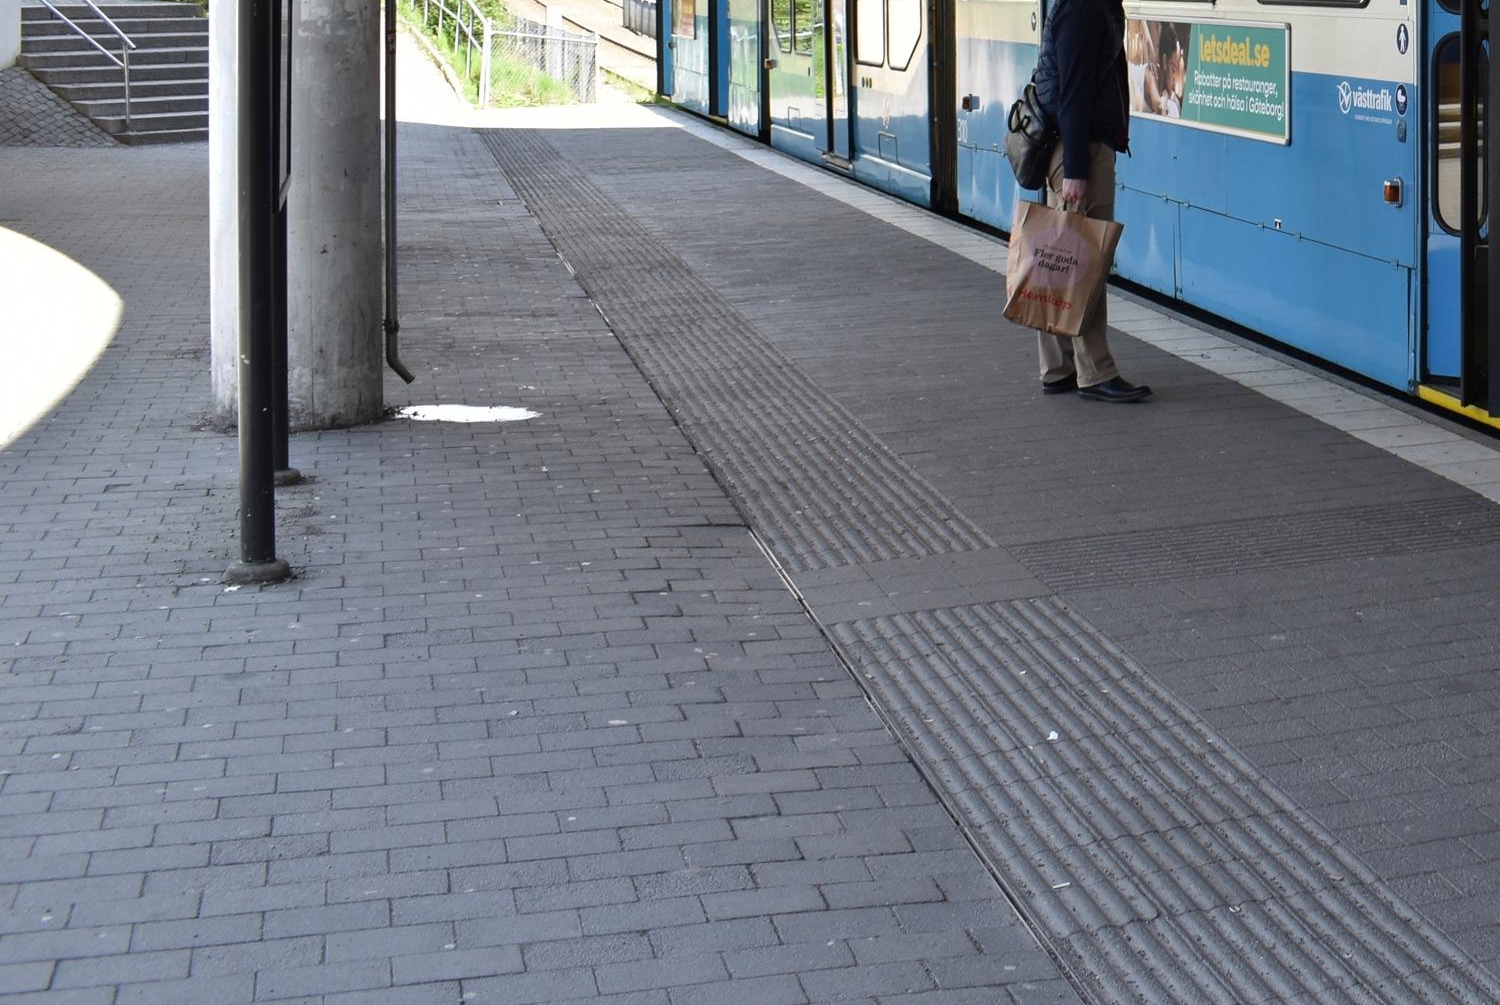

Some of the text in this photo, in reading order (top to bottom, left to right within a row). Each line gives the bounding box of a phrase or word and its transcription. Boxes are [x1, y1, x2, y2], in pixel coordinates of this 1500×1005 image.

[1200, 34, 1270, 68] letsdeal.se
[1194, 70, 1277, 97] Rabatter på restauranger,
[1189, 89, 1213, 108] skönhet
[1213, 94, 1226, 108] och
[1227, 96, 1245, 112] hälsa
[1249, 97, 1284, 121] Göteborg!
[1352, 86, 1392, 111] västtrafik
[1034, 249, 1055, 259] Fler
[1055, 255, 1078, 266] goda
